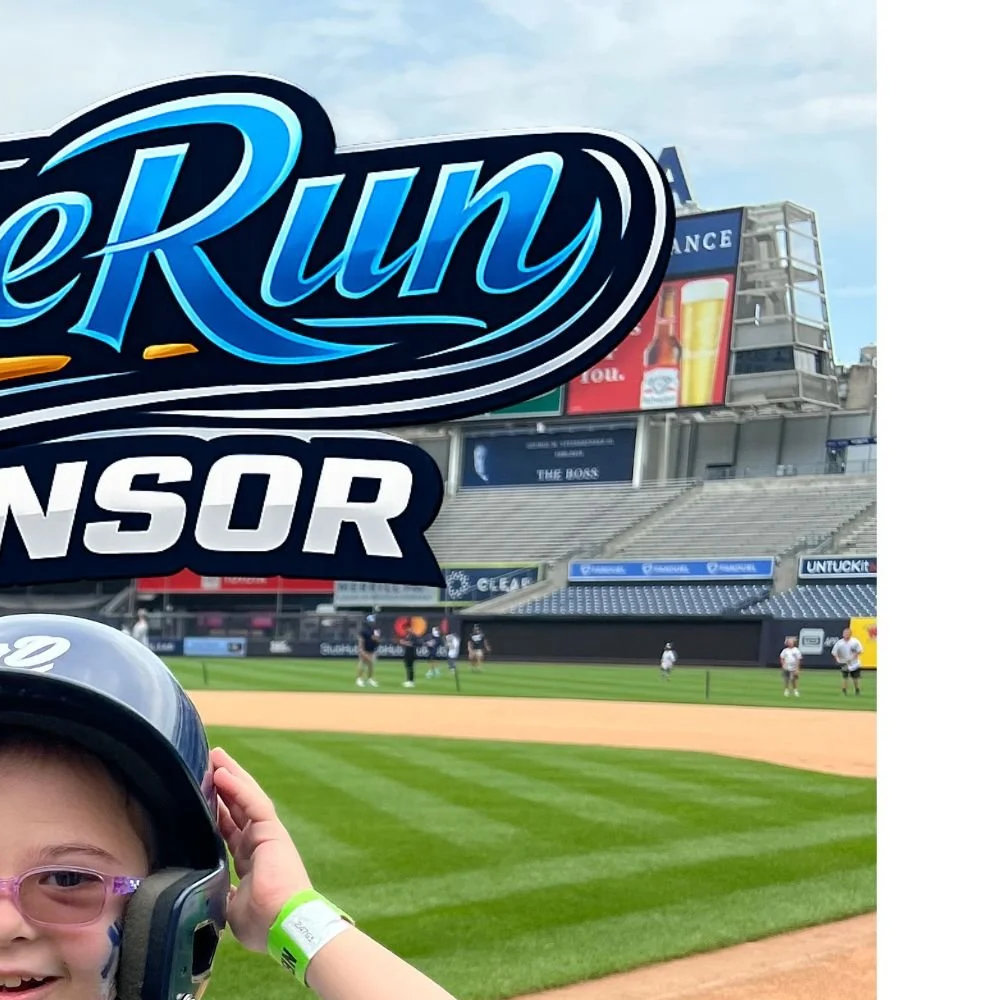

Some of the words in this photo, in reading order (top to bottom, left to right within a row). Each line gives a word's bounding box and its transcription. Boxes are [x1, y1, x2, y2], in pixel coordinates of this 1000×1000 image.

[537, 469, 563, 481] THE
[566, 467, 599, 481] BOSS
[806, 559, 869, 573] UNTUCKit
